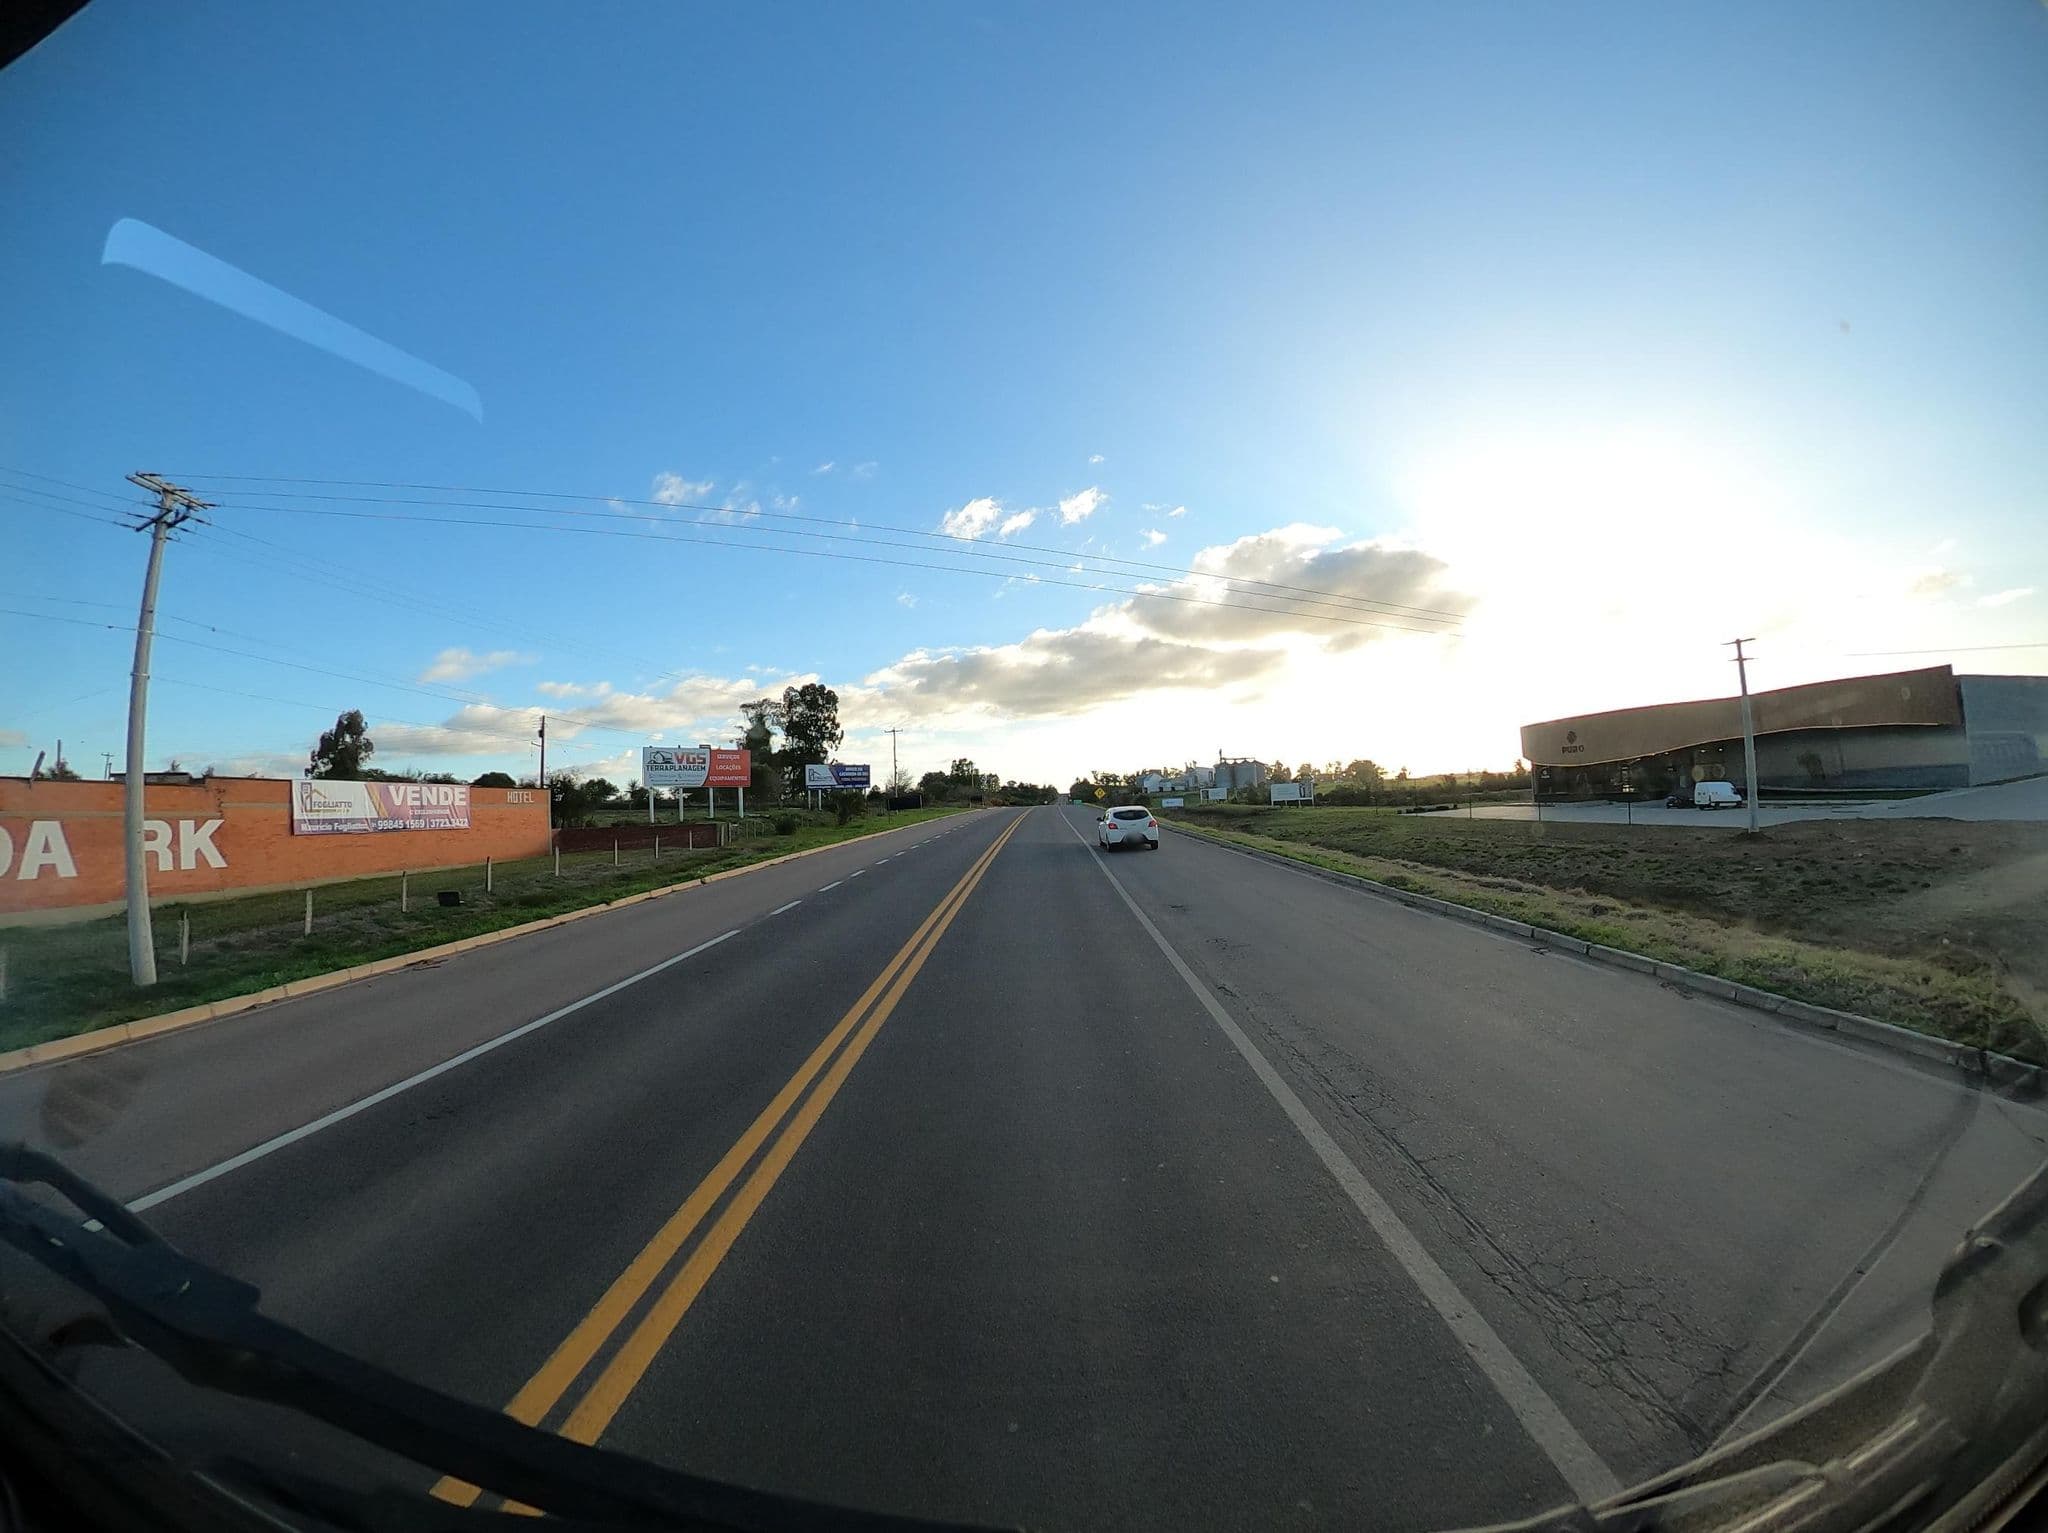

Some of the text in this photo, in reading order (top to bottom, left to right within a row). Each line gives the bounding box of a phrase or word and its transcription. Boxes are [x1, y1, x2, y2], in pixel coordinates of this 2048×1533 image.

[673, 752, 706, 765] VGS
[388, 785, 467, 806] VENDE
[507, 791, 535, 803] HOTEL
[313, 800, 353, 809] FOGLIATTO
[377, 820, 404, 830] 99845
[0, 820, 78, 880] A
